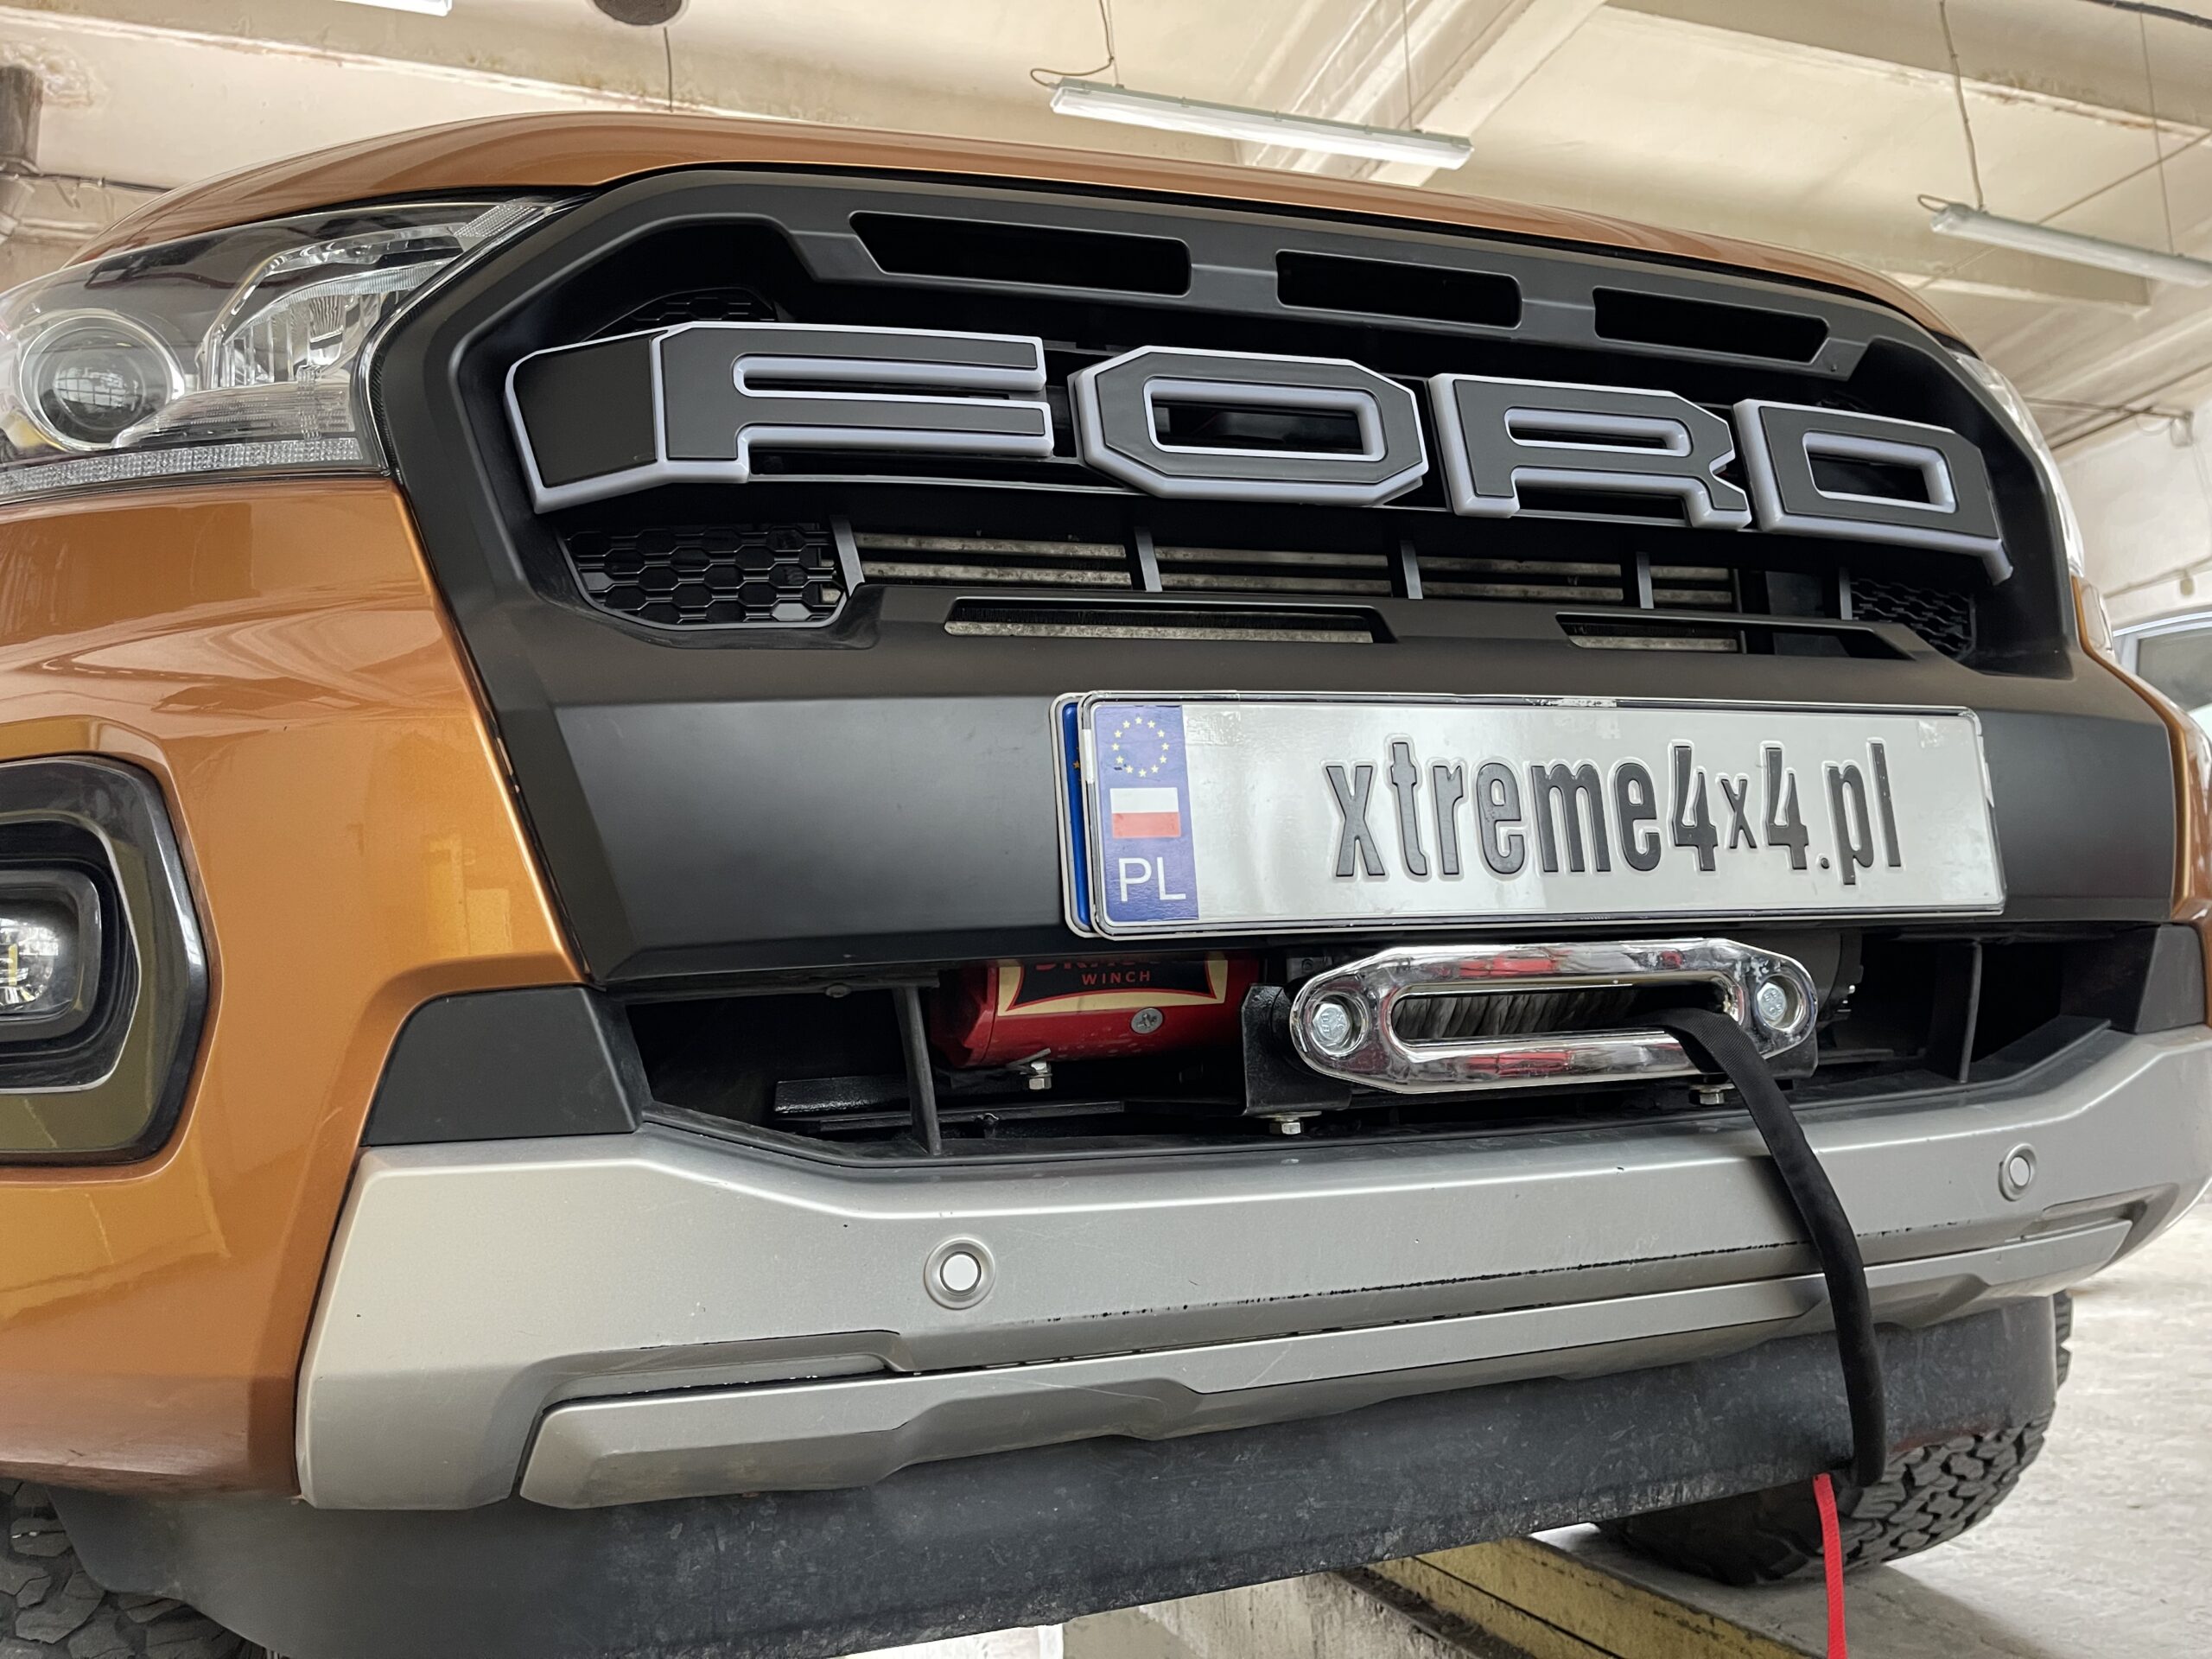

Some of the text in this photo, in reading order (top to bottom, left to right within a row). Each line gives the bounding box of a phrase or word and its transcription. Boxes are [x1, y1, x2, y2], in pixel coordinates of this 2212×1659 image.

[506, 321, 2013, 586] FORD
[1325, 739, 1902, 886] xtreme4x4.pl
[1118, 856, 1186, 902] PL
[1082, 970, 1150, 985] WINCH
